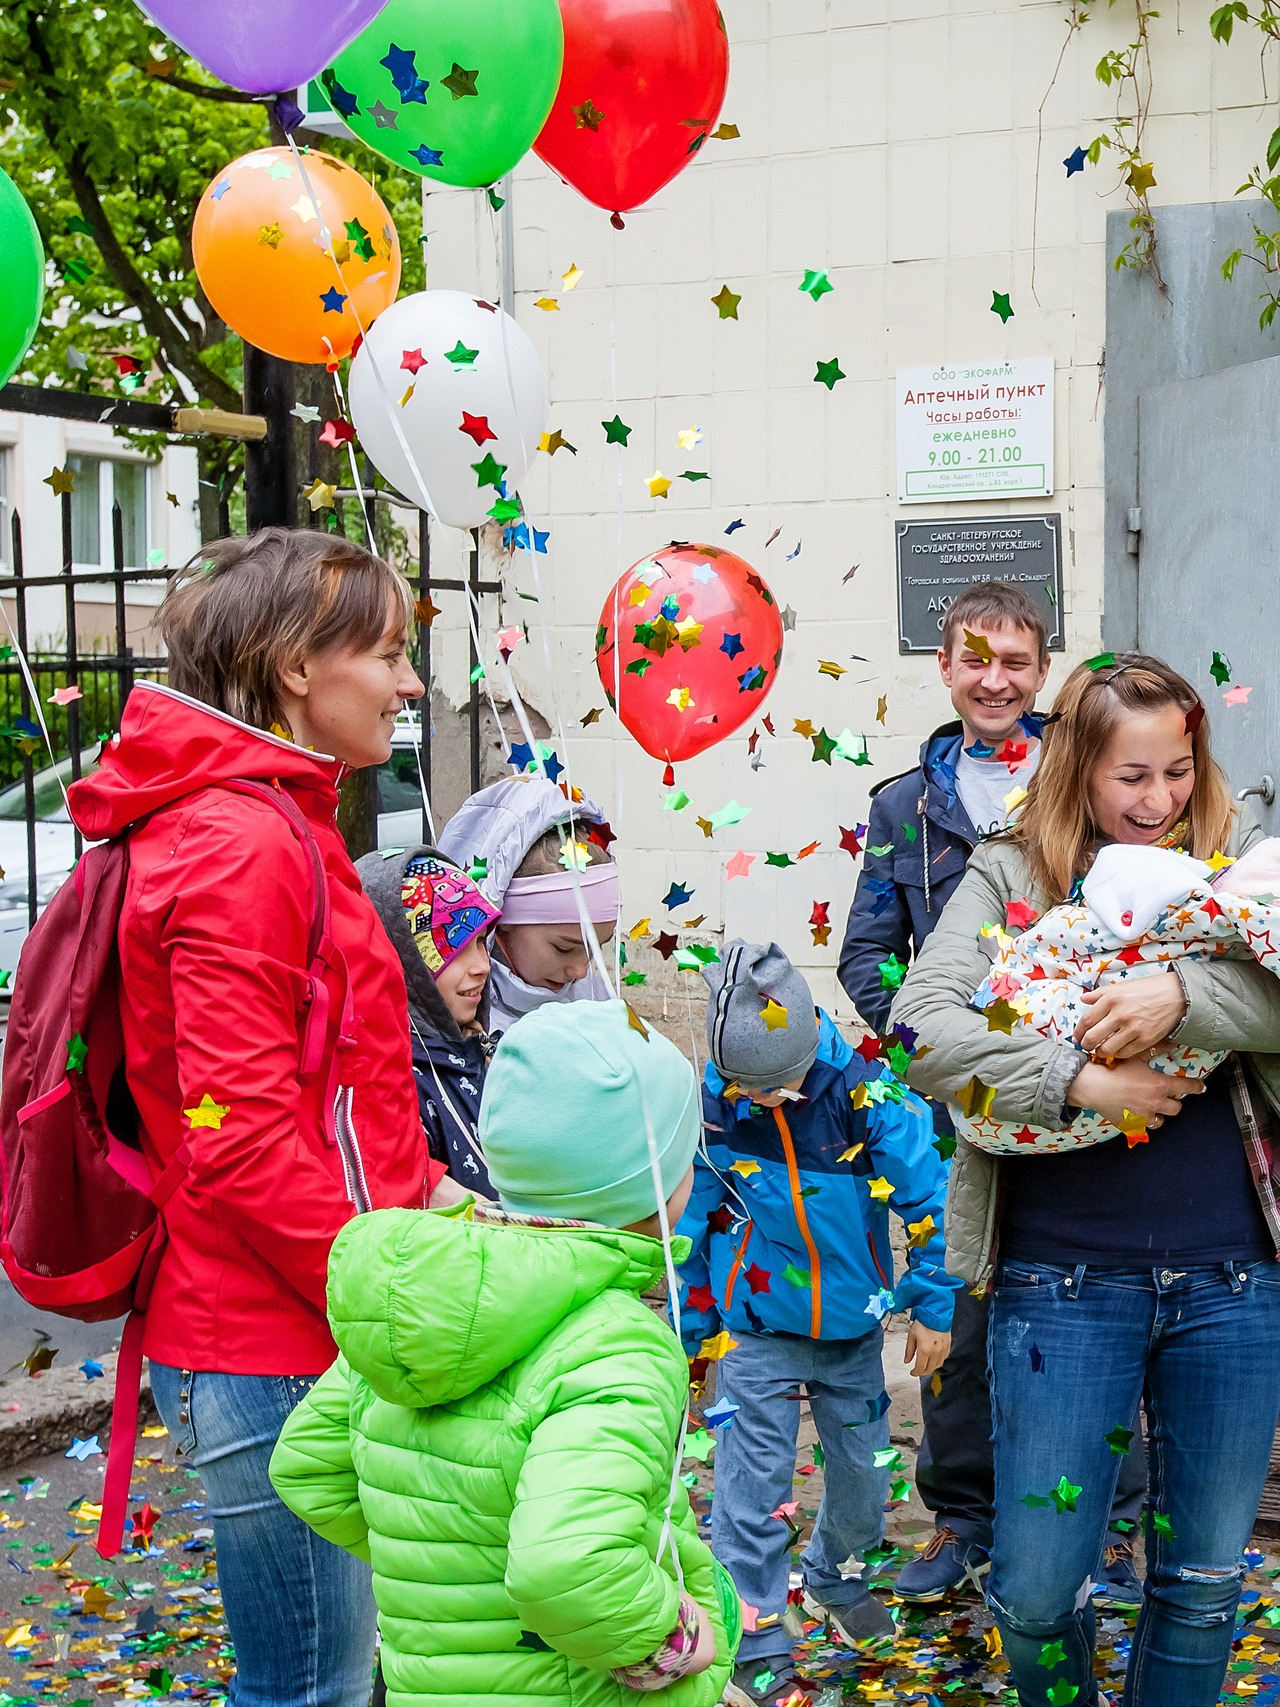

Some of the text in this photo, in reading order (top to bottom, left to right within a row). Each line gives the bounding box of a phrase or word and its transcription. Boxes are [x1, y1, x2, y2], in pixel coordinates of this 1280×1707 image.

[932, 366, 1017, 381] ООО "ЭКОФАРМ"
[904, 383, 1046, 406] Аптечный пункт
[926, 407, 1022, 424] Часы работы:
[933, 428, 1017, 443] ежедневно
[928, 450, 961, 467] 9.00
[978, 446, 1022, 464] 21.00
[930, 529, 1022, 541] САНКТ-ПЕТЕРБУРГСКОЕ
[911, 540, 1042, 553] ГОСУДАРСТВЕННОЕ УЧРЕЖДЕНИЕ
[939, 552, 1015, 564] ЗДРАВООХРАНЕНИЯ
